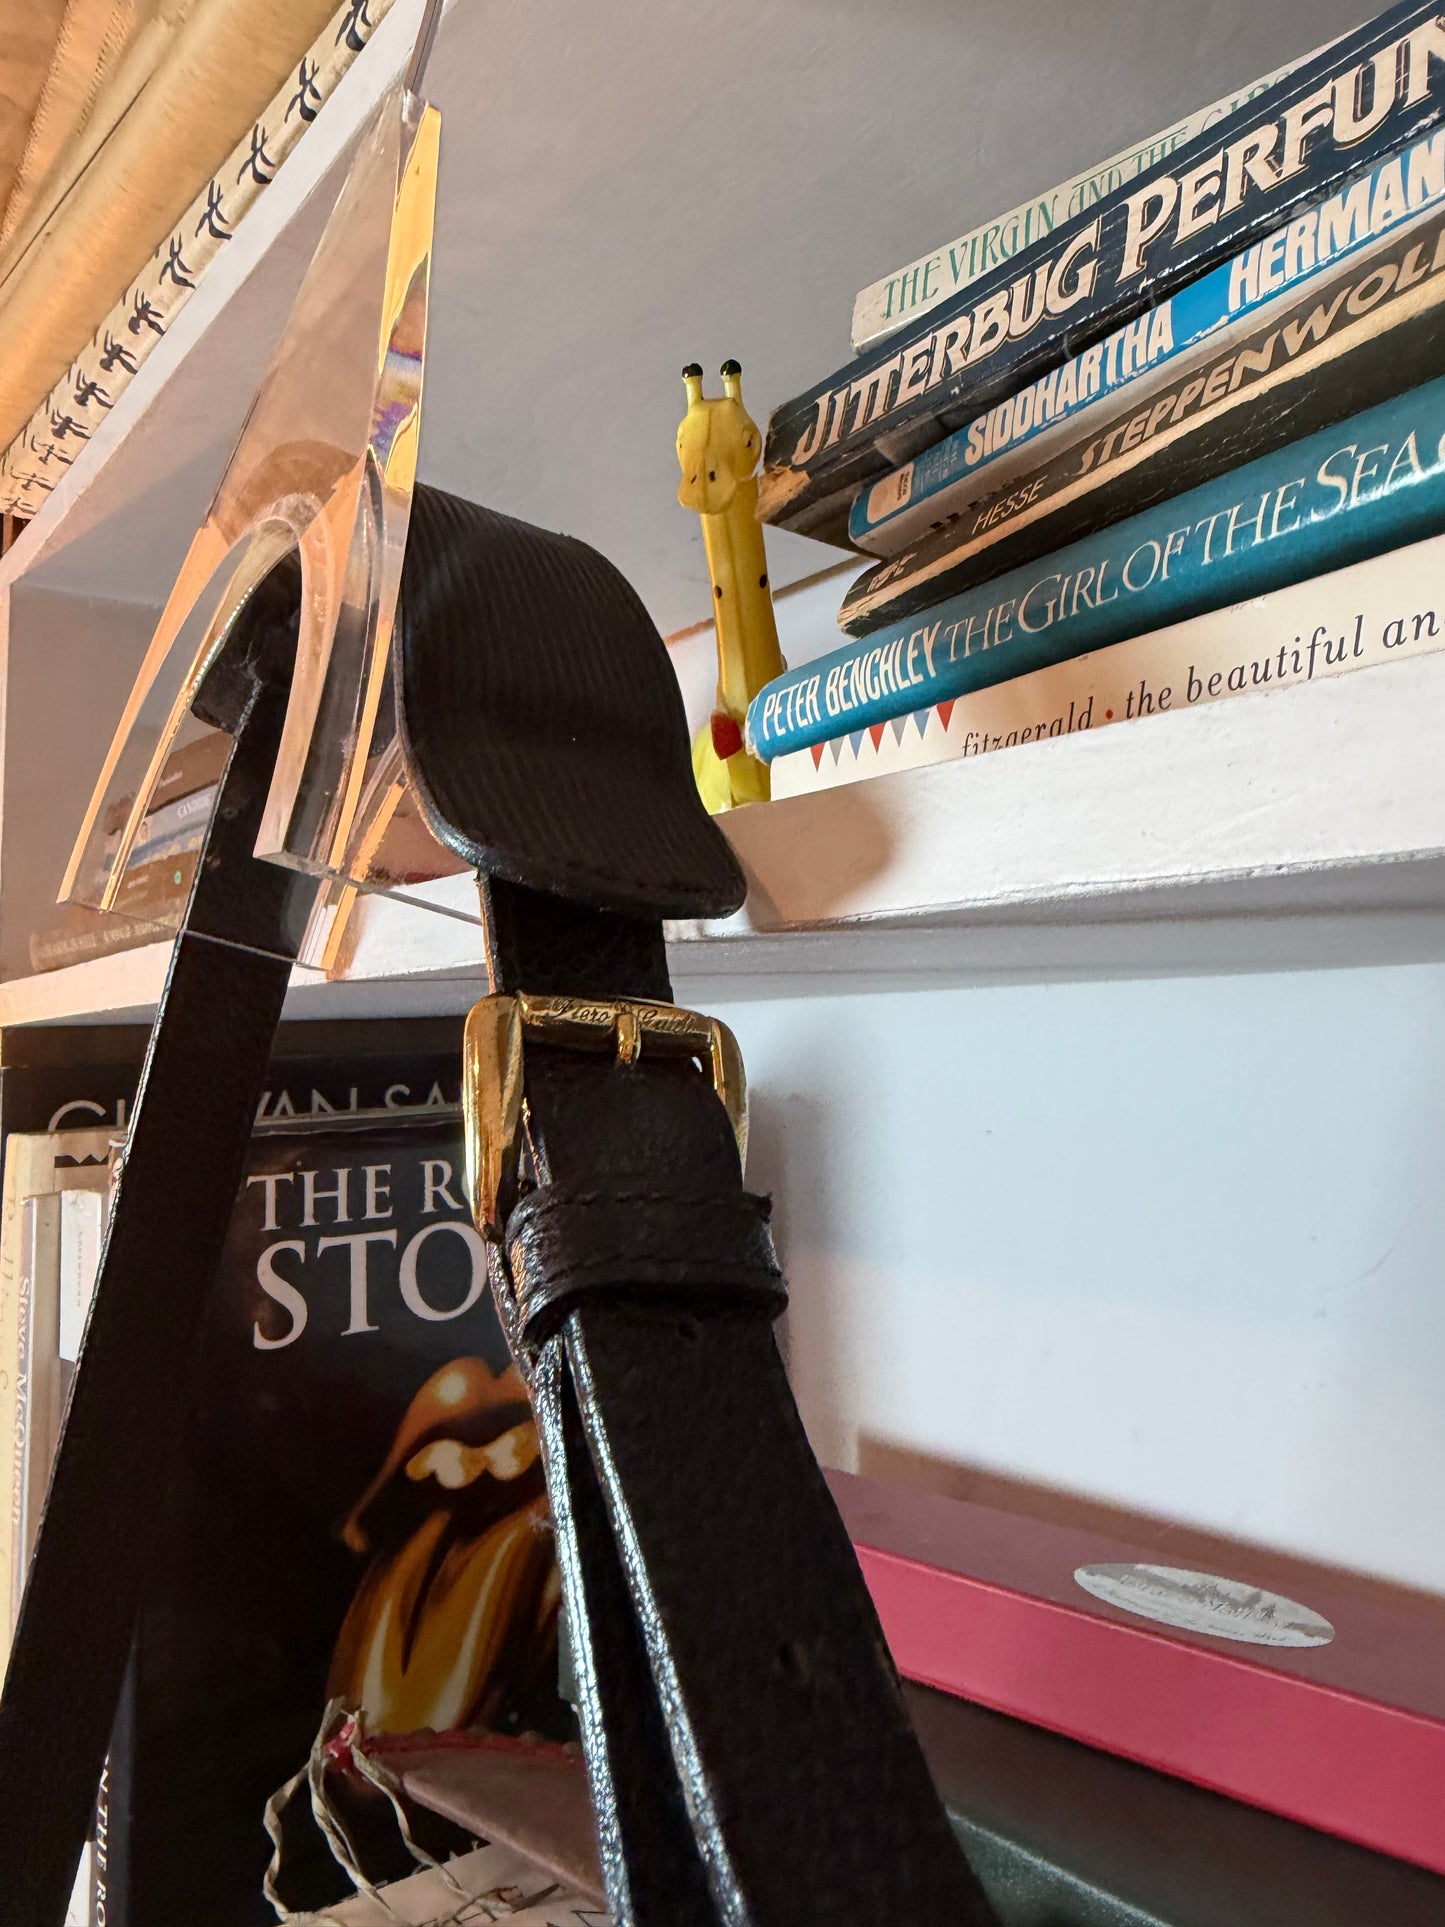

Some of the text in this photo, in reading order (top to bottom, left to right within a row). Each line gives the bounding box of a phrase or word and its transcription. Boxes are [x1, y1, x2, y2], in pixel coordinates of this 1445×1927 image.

[881, 130, 1187, 319] THE VIRGIN AND THE
[964, 128, 1445, 466] SIDDHARTHA HERMAN
[791, 214, 1103, 466] JITTERBUG
[972, 475, 1048, 535] HESSE
[762, 673, 821, 741] PETER
[825, 621, 942, 718] BENCHLEY
[943, 598, 1016, 664] THE
[1018, 559, 1118, 634] GIRL
[1122, 526, 1191, 592] OF
[1195, 477, 1306, 567] THE
[1316, 429, 1426, 520] SEA
[1125, 680, 1173, 720] the
[1186, 614, 1365, 704] beautiful
[1382, 610, 1445, 649] an
[246, 1159, 472, 1231] THE R
[254, 1221, 488, 1350] STO
[12, 1276, 30, 1524] Steve McQueen
[96, 1804, 108, 1872] THE
